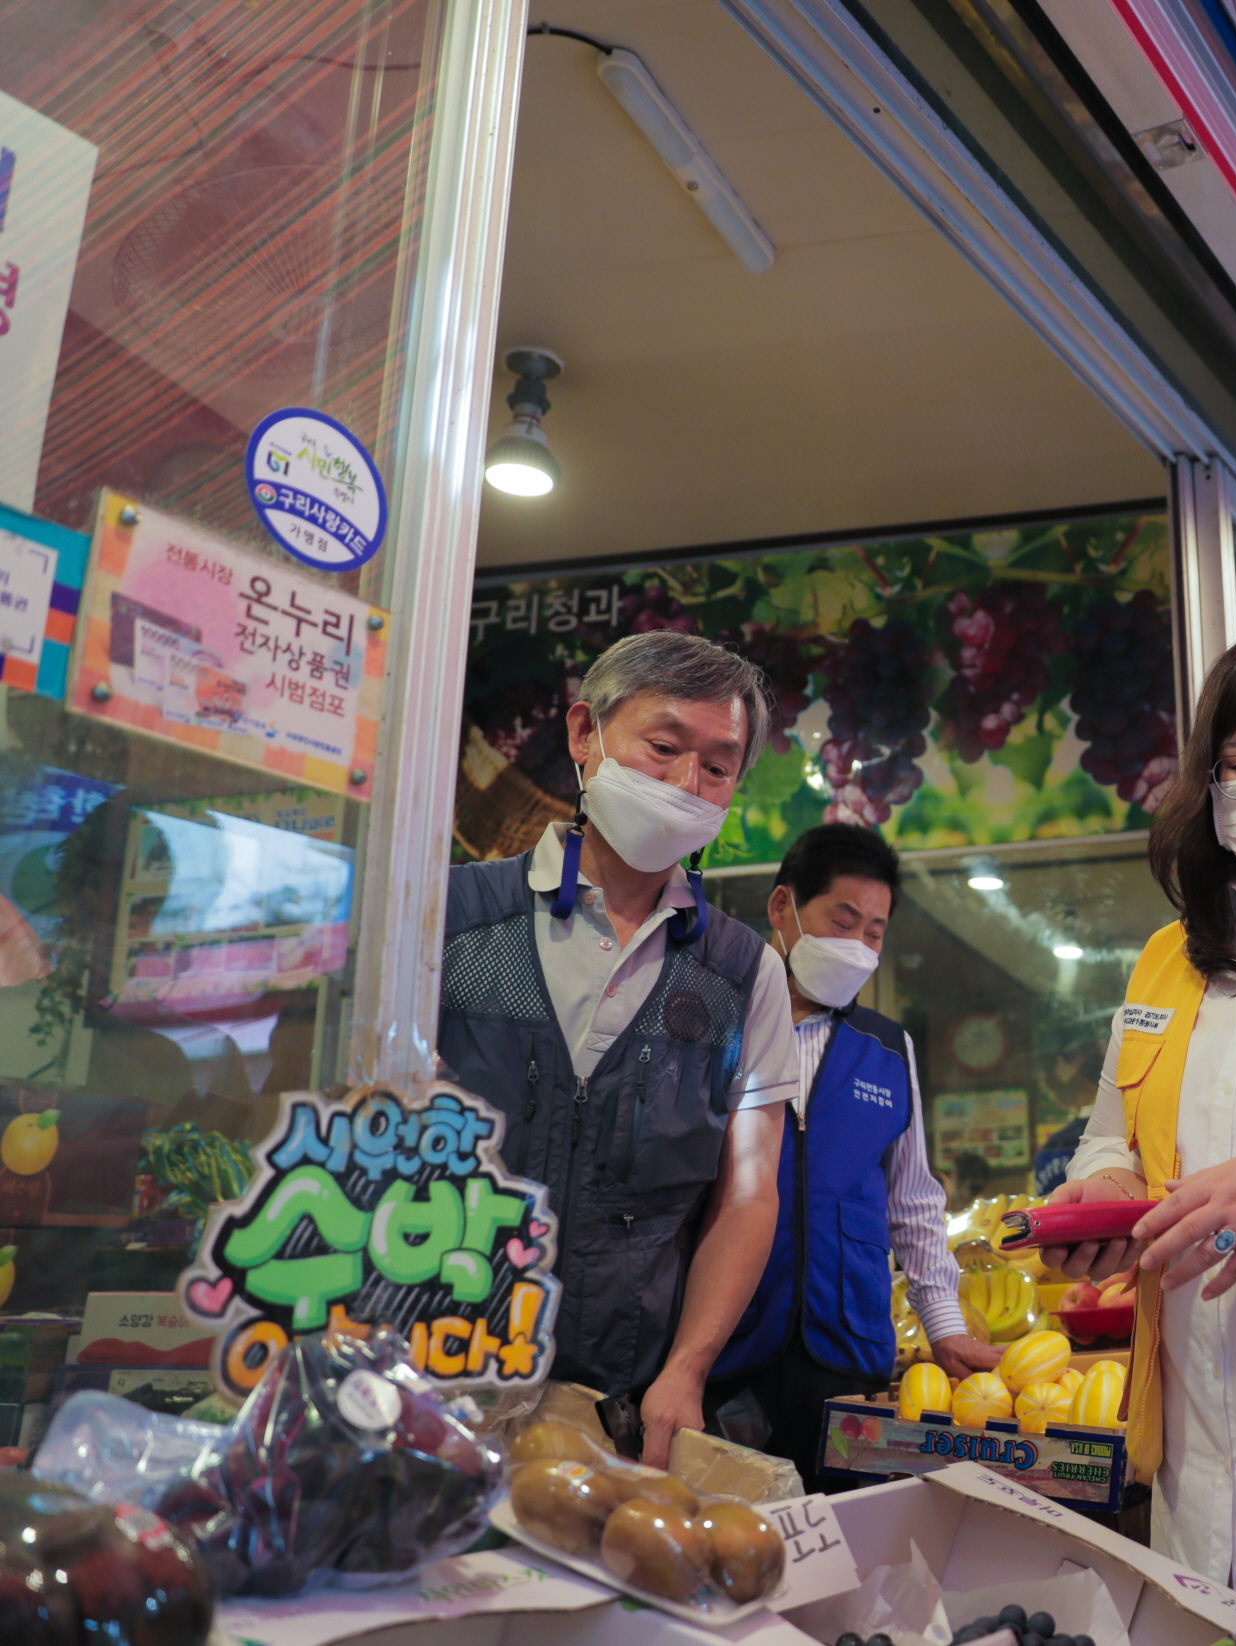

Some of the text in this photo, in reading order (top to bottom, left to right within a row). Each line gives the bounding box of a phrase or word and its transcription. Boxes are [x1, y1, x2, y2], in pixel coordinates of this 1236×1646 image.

[278, 488, 368, 557] 구리사랑카드
[289, 522, 329, 553] 가맹점
[165, 543, 234, 587] 전통시장
[237, 574, 356, 657] 온누리
[469, 584, 624, 642] 구리청과
[235, 623, 351, 691] 전자상품권
[265, 671, 347, 718] 시범점포
[271, 1094, 495, 1181] 시원한
[222, 1164, 527, 1331] 수박
[118, 1314, 154, 1328] 소양강
[919, 1430, 1039, 1471] Cruiser
[1051, 1461, 1111, 1477] CHERRIES
[1090, 1444, 1112, 1458] PRODUCE
[1052, 1471, 1106, 1483] CHELAN FRUIT
[769, 1498, 842, 1564] 포도
